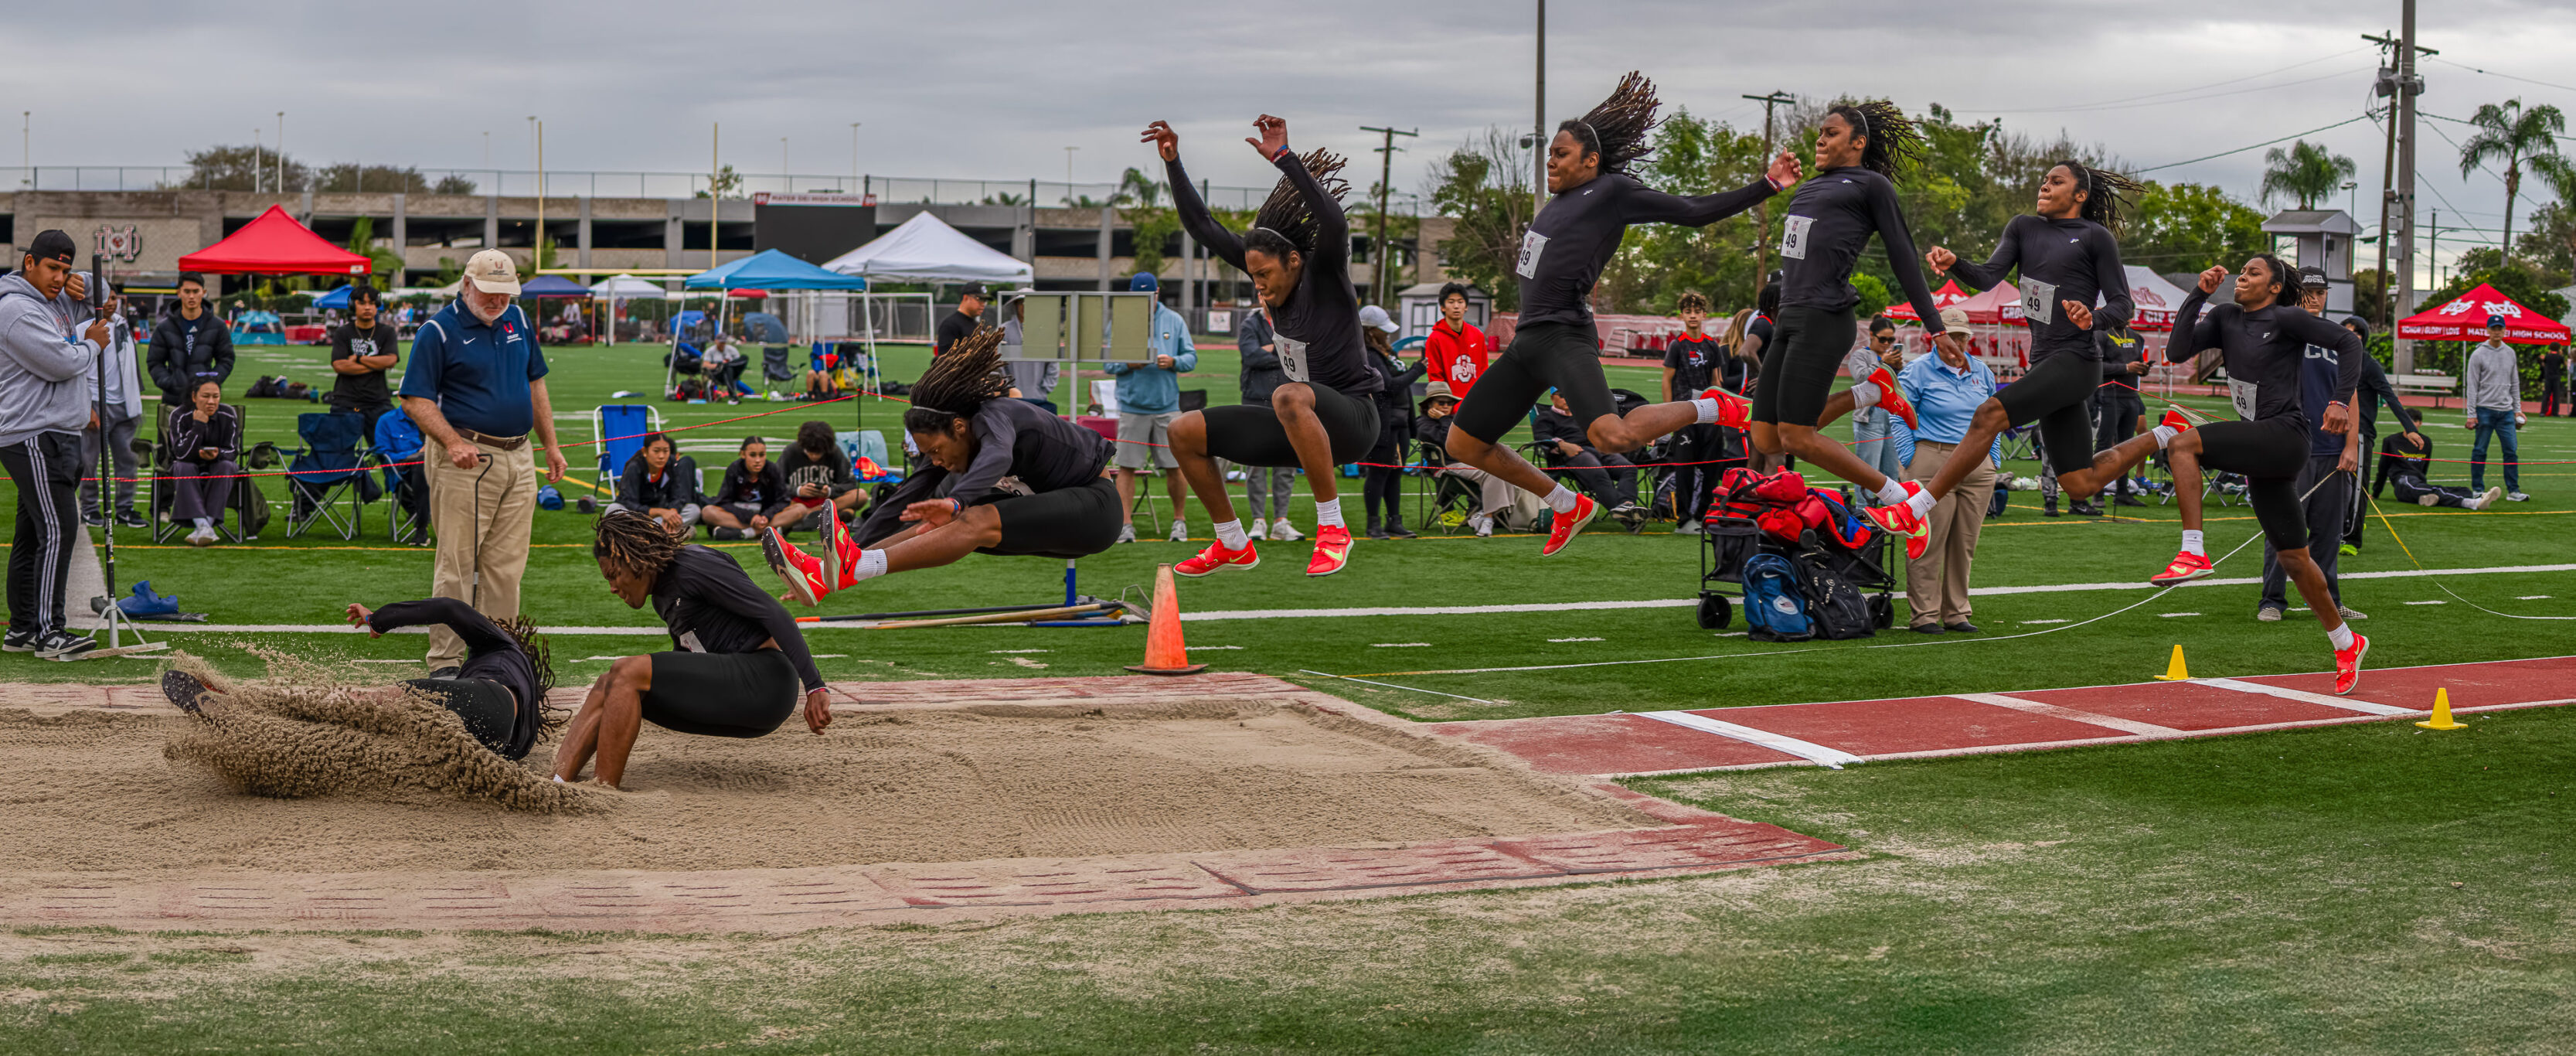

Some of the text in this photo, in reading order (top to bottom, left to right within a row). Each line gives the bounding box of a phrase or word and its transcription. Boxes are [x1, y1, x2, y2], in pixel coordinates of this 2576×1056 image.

[1785, 233, 1797, 248] 49
[1520, 249, 1531, 266] 49
[2027, 297, 2040, 312] 49
[2425, 326, 2442, 335] GLORY
[2445, 327, 2460, 336] LOVE
[2533, 331, 2567, 340] SCHOOL
[1284, 356, 1296, 373] 49
[2236, 395, 2247, 410] 49
